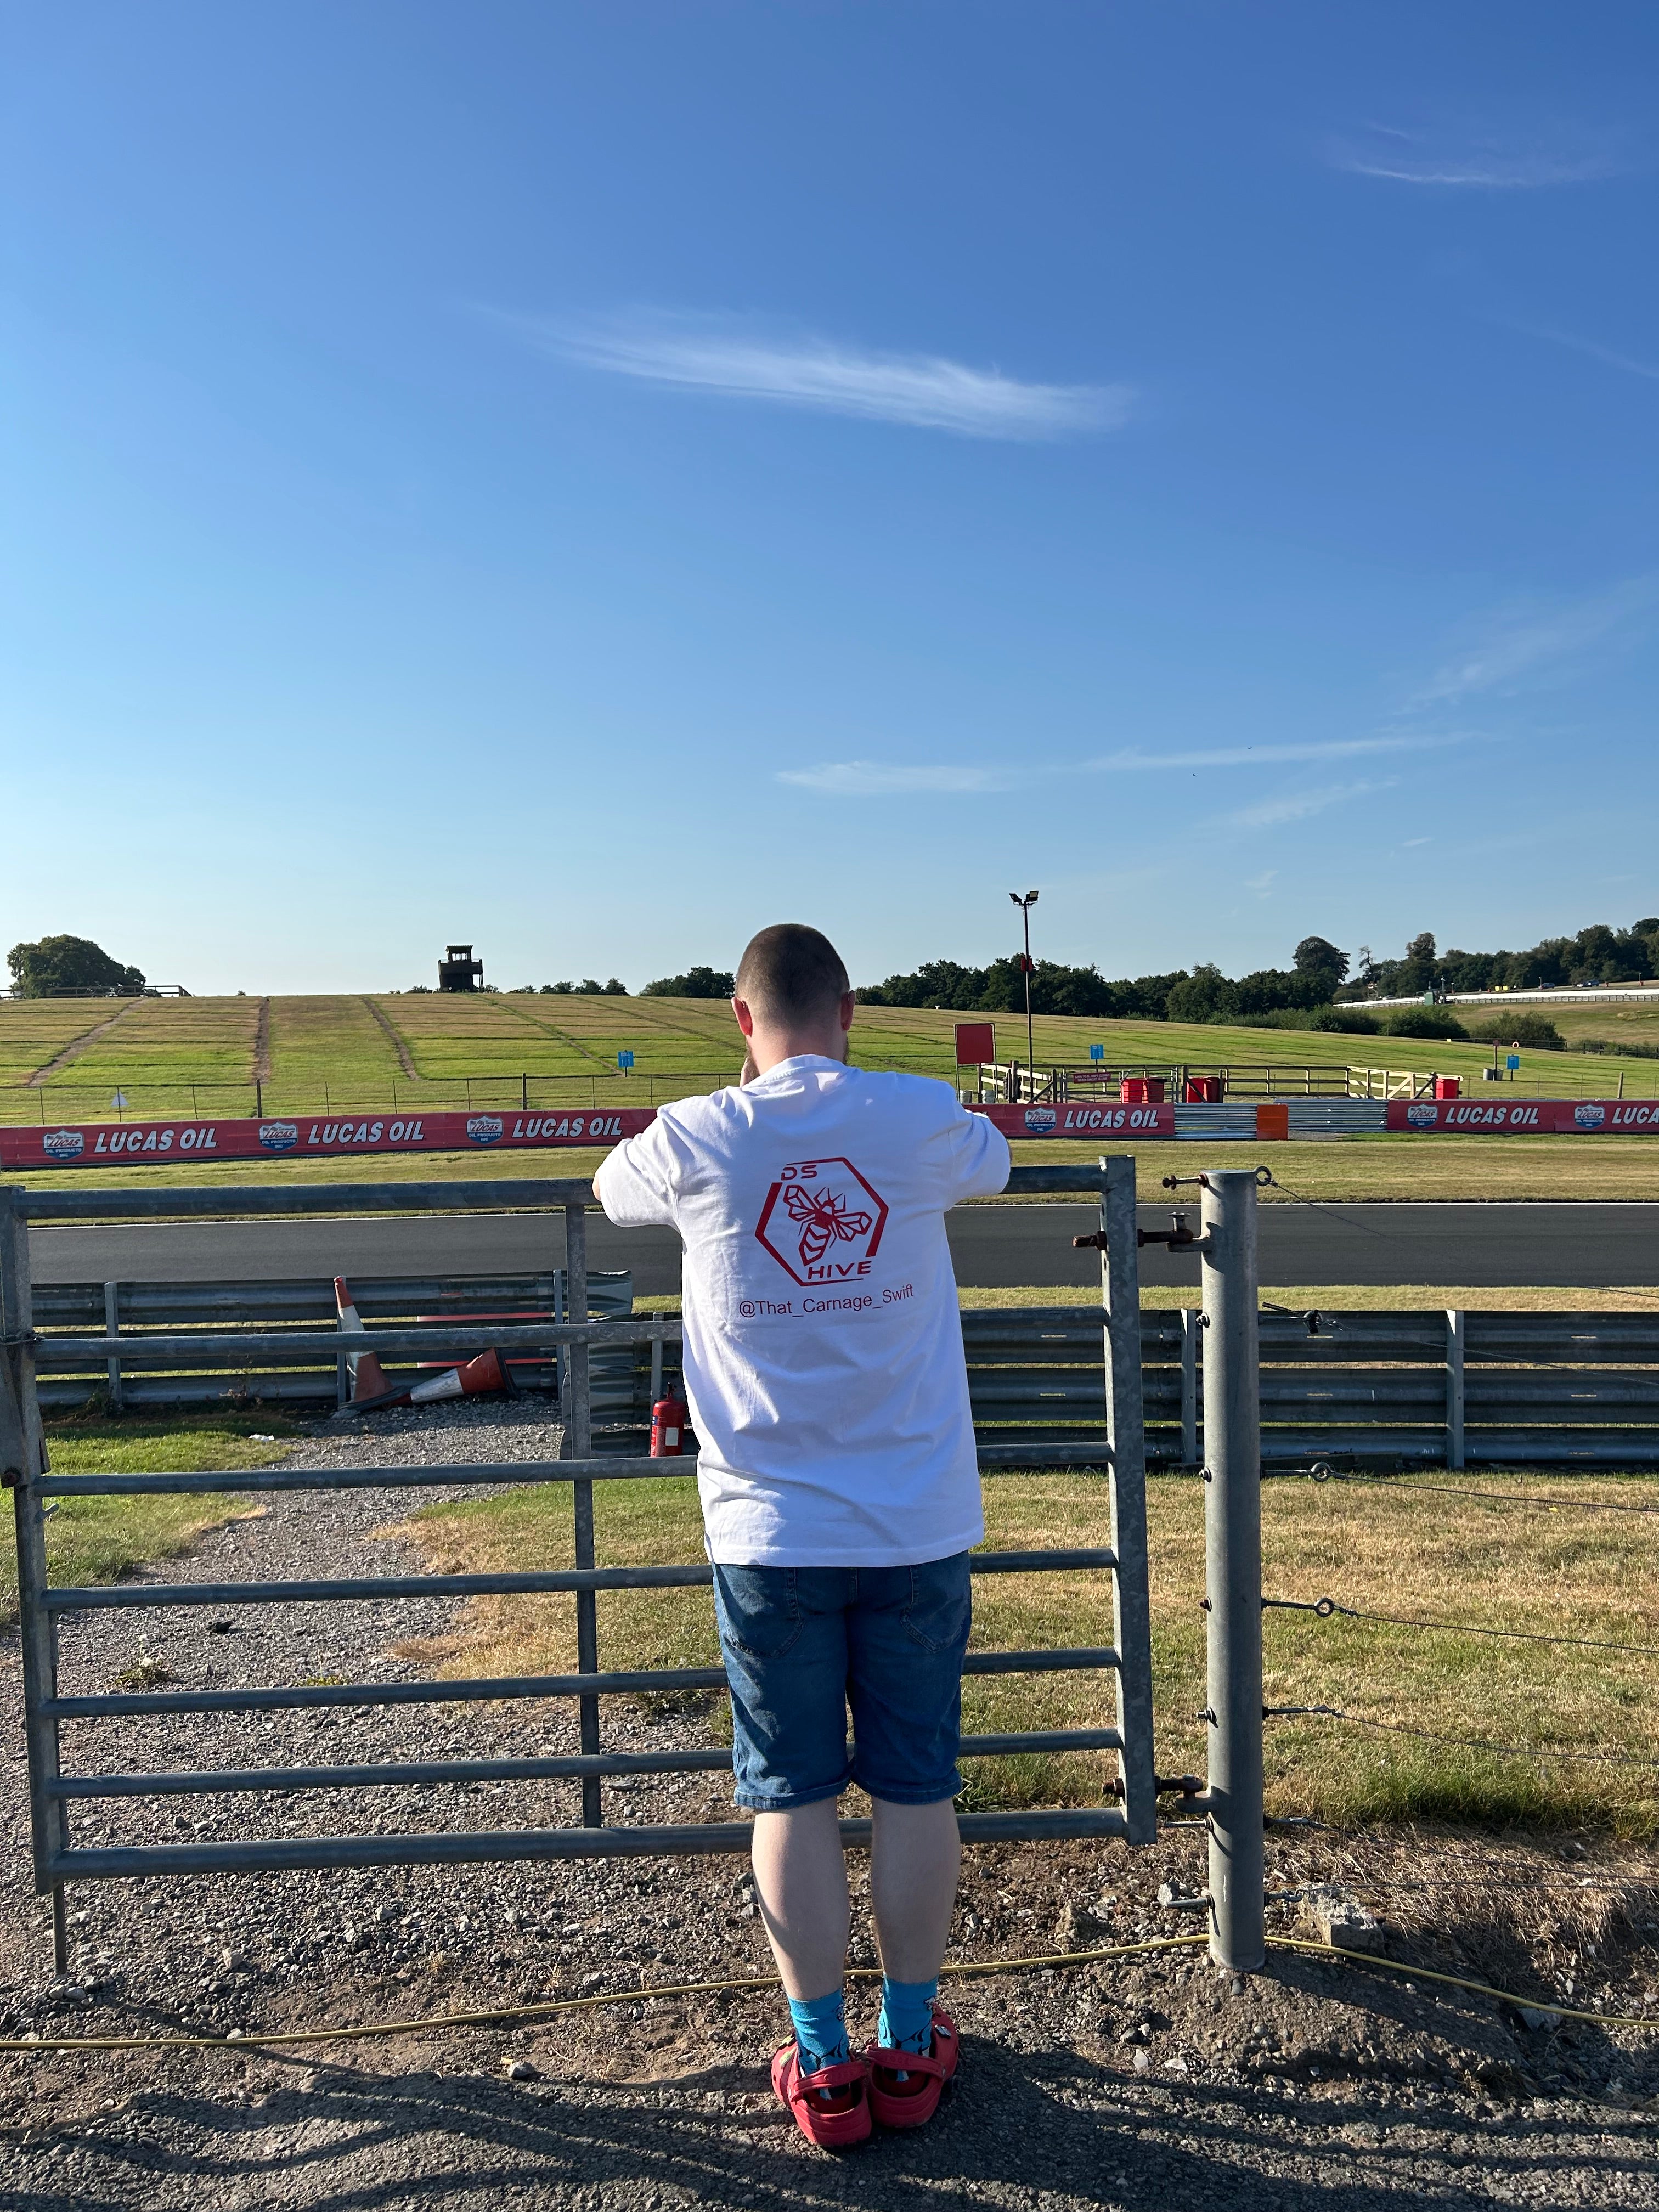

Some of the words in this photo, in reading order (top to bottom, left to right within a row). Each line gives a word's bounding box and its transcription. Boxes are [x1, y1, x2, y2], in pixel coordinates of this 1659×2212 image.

[1064, 1110, 1126, 1128] LUCAS
[1130, 1110, 1159, 1128] OIL
[1444, 1107, 1507, 1124] LUCAS
[1510, 1107, 1539, 1124] OIL
[307, 1122, 384, 1144] LUCAS
[389, 1121, 424, 1141] OIL
[512, 1118, 584, 1138] LUCAS
[589, 1117, 622, 1136] OIL
[48, 1139, 81, 1147] LUCAS
[94, 1130, 174, 1153] LUCAS
[179, 1128, 217, 1149] OIL
[781, 1164, 817, 1181] DS
[807, 1260, 872, 1280] HIVE
[739, 1284, 914, 1318] @That_Carnage_Swift
